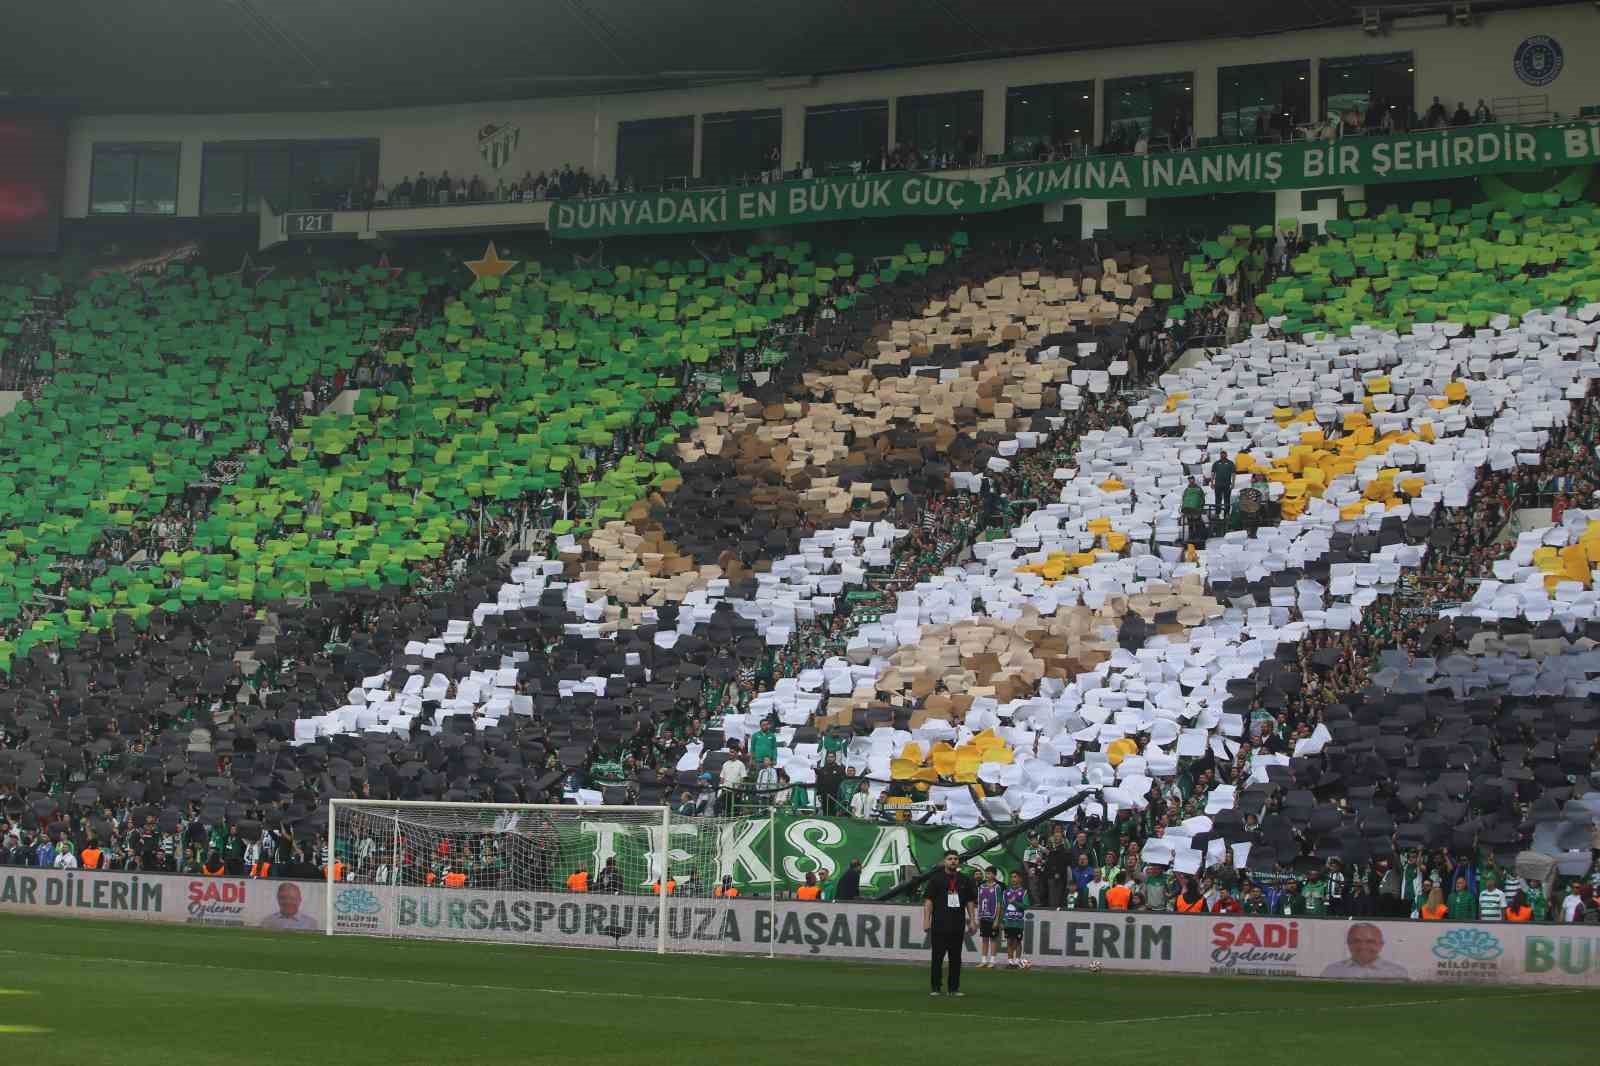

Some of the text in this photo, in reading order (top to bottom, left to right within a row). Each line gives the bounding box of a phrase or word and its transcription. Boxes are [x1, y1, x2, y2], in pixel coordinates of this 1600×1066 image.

[557, 190, 727, 229] DÜNYADAKİ
[738, 191, 777, 220] EN
[788, 176, 892, 215] BÜYÜK
[1142, 151, 1283, 188] İNANMIŞ
[1303, 140, 1360, 178] BİR
[297, 215, 322, 231] 121
[2, 871, 162, 912] AR DİLERİM
[399, 895, 1172, 960] BURSASPORUMUZA BAŞARIL İLERİM
